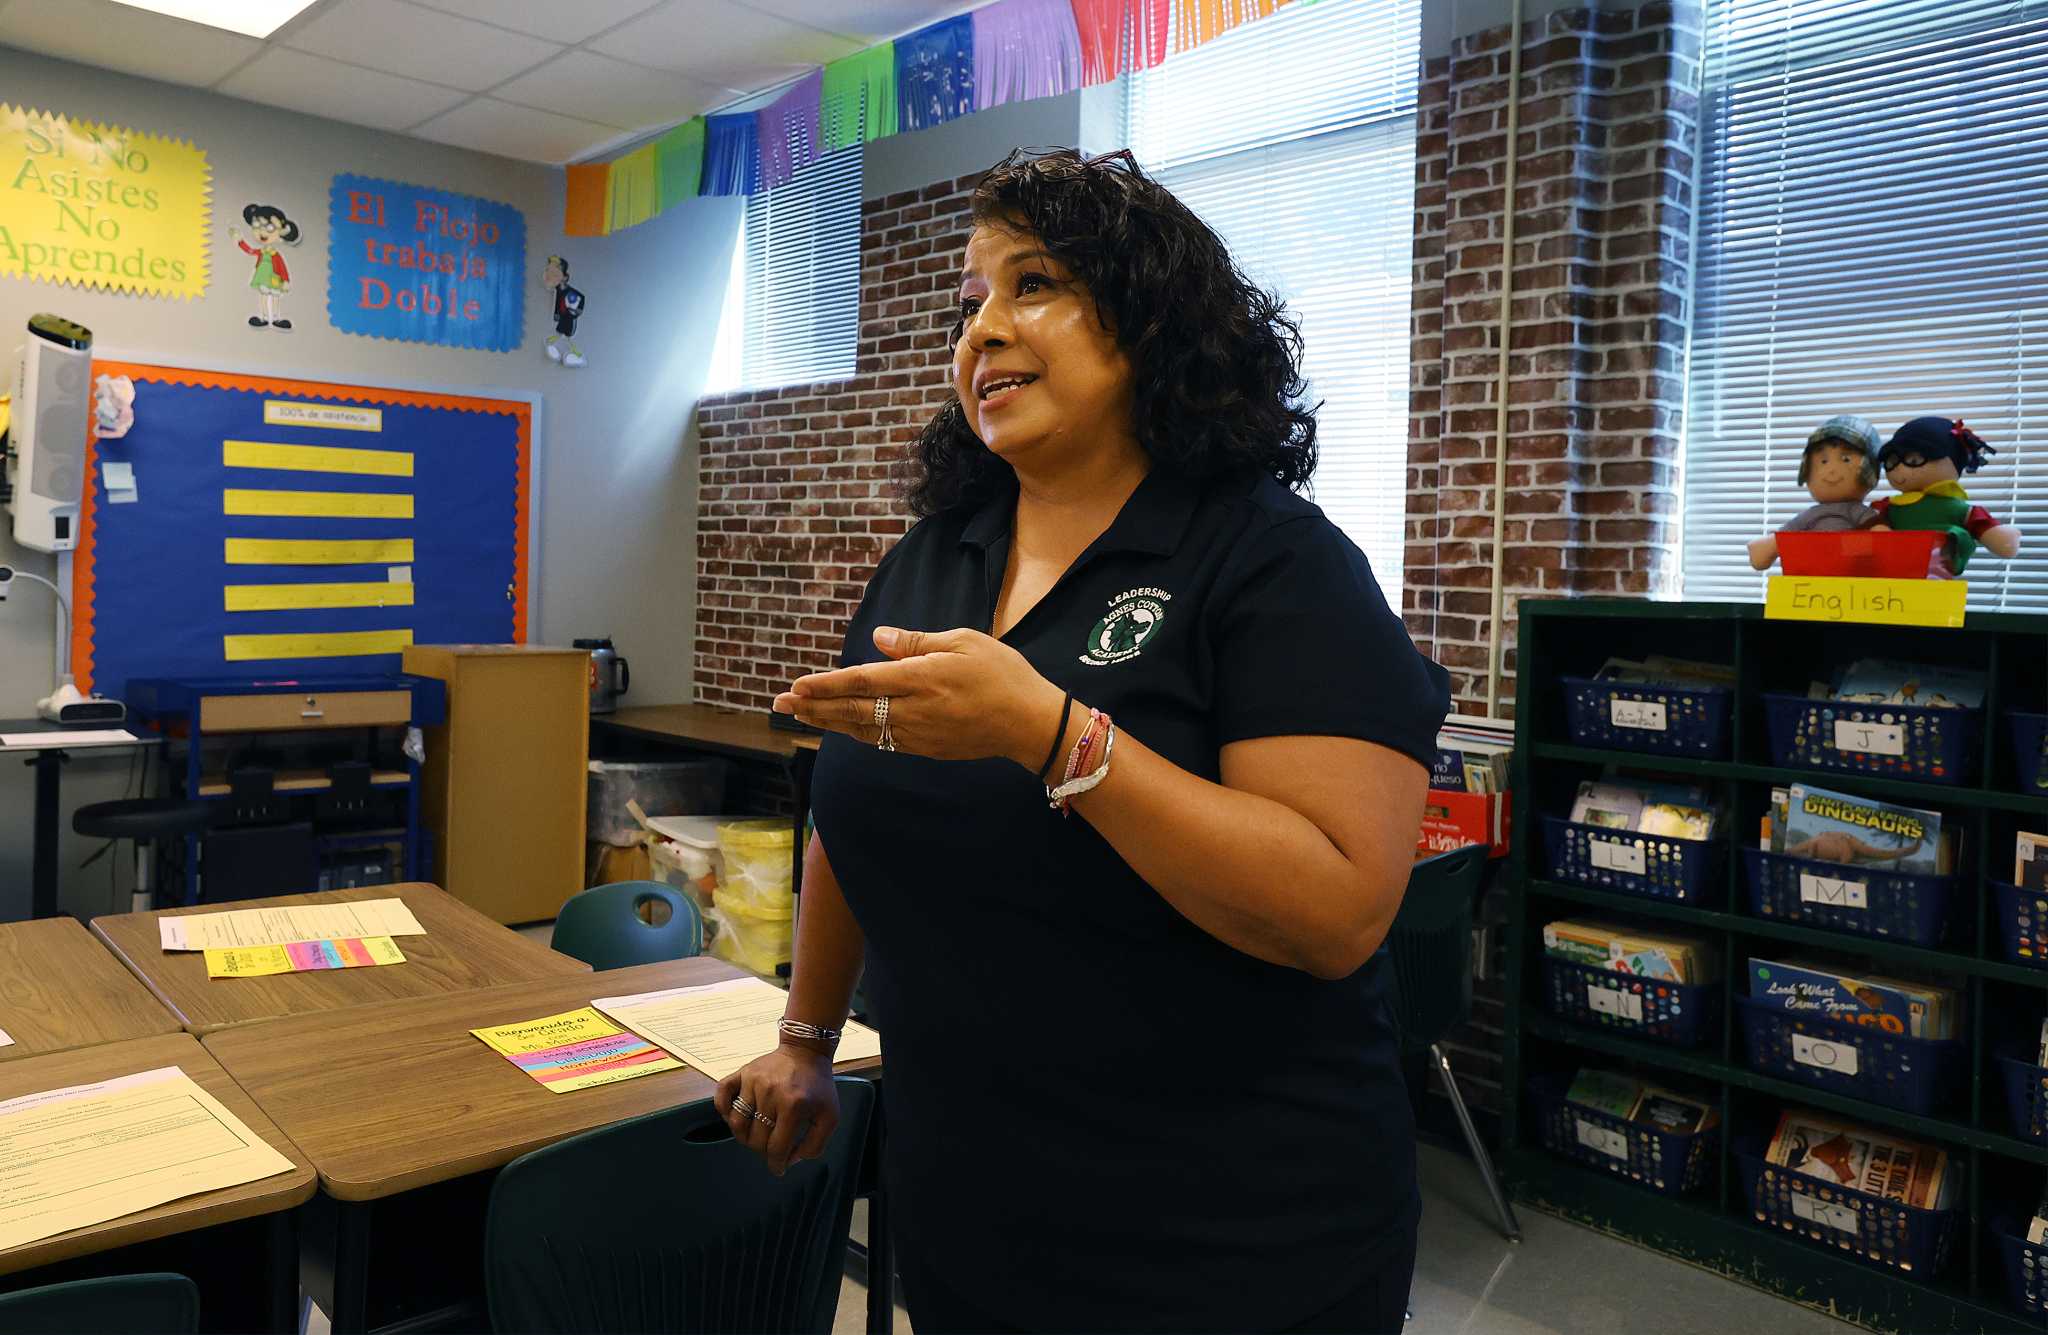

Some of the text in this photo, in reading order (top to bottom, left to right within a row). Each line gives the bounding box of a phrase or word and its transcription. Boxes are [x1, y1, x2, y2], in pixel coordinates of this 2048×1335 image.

[88, 131, 149, 174] No
[11, 158, 160, 212] Asistes
[53, 199, 121, 242] No
[347, 190, 500, 248] El Flojo
[0, 225, 188, 282] Aprendes
[364, 238, 487, 282] trabaja
[356, 277, 481, 321] Doble
[308, 410, 319, 419] de
[1107, 587, 1172, 607] LEADERSHIP
[1792, 582, 1905, 620] English
[1103, 599, 1165, 624] AGNES COTTON
[1090, 644, 1141, 659] ACADEMY
[1857, 729, 1874, 749] J
[1803, 799, 1924, 840] DINOSAURS
[1610, 848, 1628, 869] L
[1815, 879, 1848, 906] M
[1784, 996, 1860, 1013] Came From
[1798, 983, 1836, 999] What
[1616, 994, 1630, 1016] N
